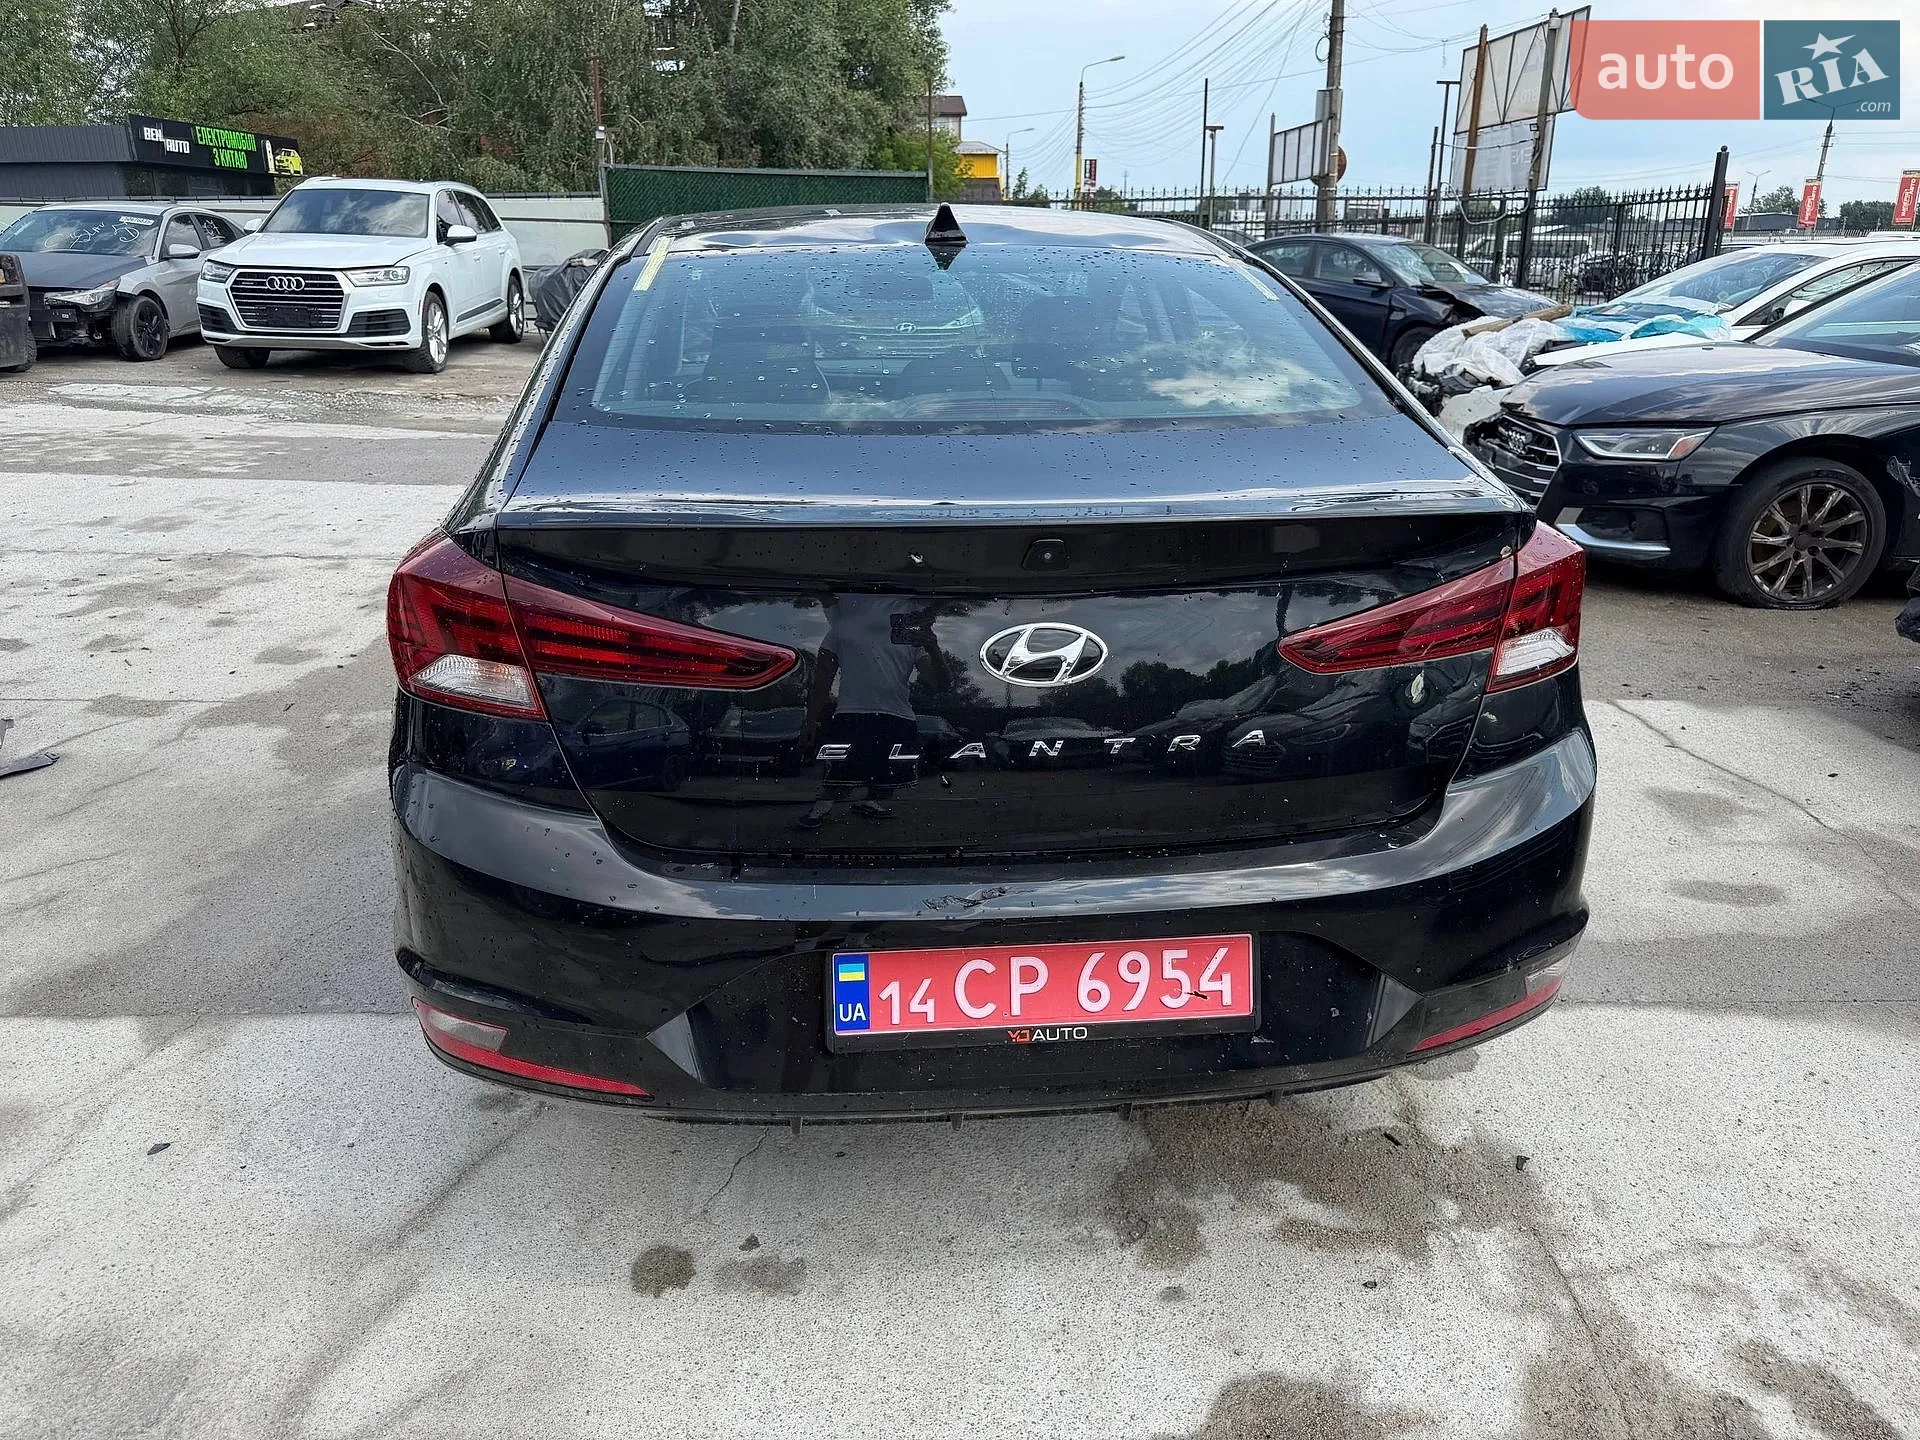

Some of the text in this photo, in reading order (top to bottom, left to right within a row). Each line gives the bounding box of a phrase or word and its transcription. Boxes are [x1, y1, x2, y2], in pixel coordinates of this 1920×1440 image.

[143, 126, 163, 142] BEN
[166, 138, 190, 154] AUTO
[220, 149, 248, 170] КИТАЮ
[816, 729, 1267, 760] ELANTRA
[878, 978, 936, 1025] 14
[1076, 948, 1232, 1013] 6954
[838, 1002, 867, 1023] UA
